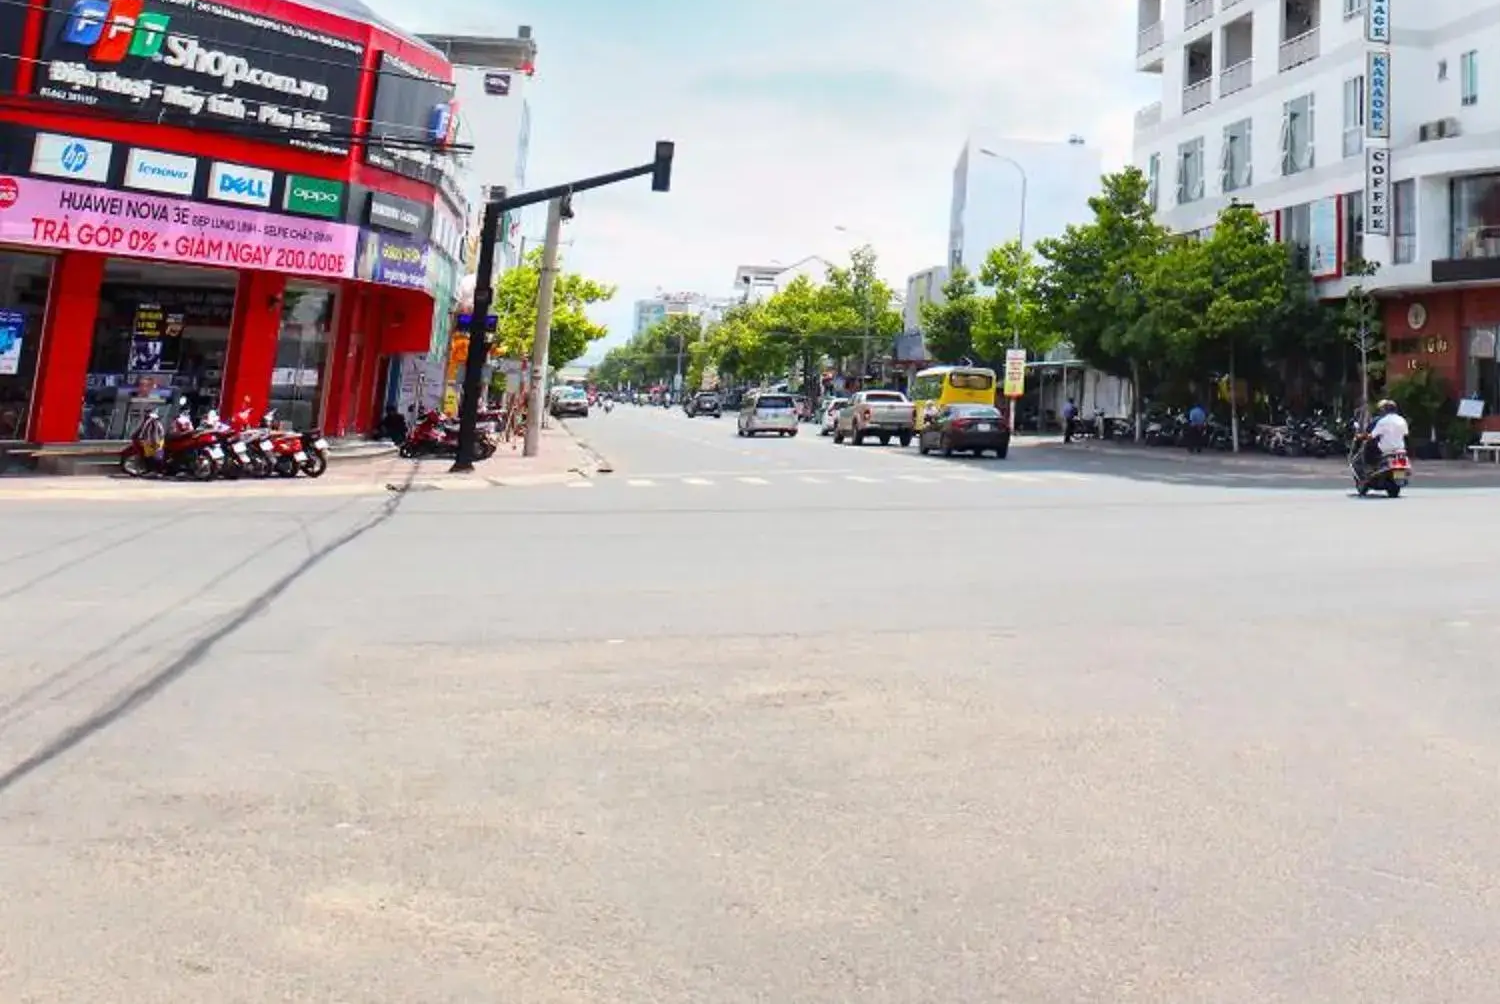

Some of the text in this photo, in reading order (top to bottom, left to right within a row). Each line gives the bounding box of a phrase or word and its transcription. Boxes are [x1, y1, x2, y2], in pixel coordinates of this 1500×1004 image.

[72, 4, 167, 52] FPT
[1372, 57, 1384, 131] KARAOKE
[62, 143, 88, 173] hp
[60, 191, 123, 216] HUAWEI
[125, 200, 169, 222] NOVA
[173, 207, 190, 226] 3E
[219, 173, 266, 197] DELL
[1372, 152, 1384, 229] COFFEE
[32, 214, 70, 243] TRẢ
[78, 220, 124, 247] GÓP
[128, 229, 160, 253] 0%
[175, 232, 223, 259] GIẢM
[226, 242, 273, 265] NGAY
